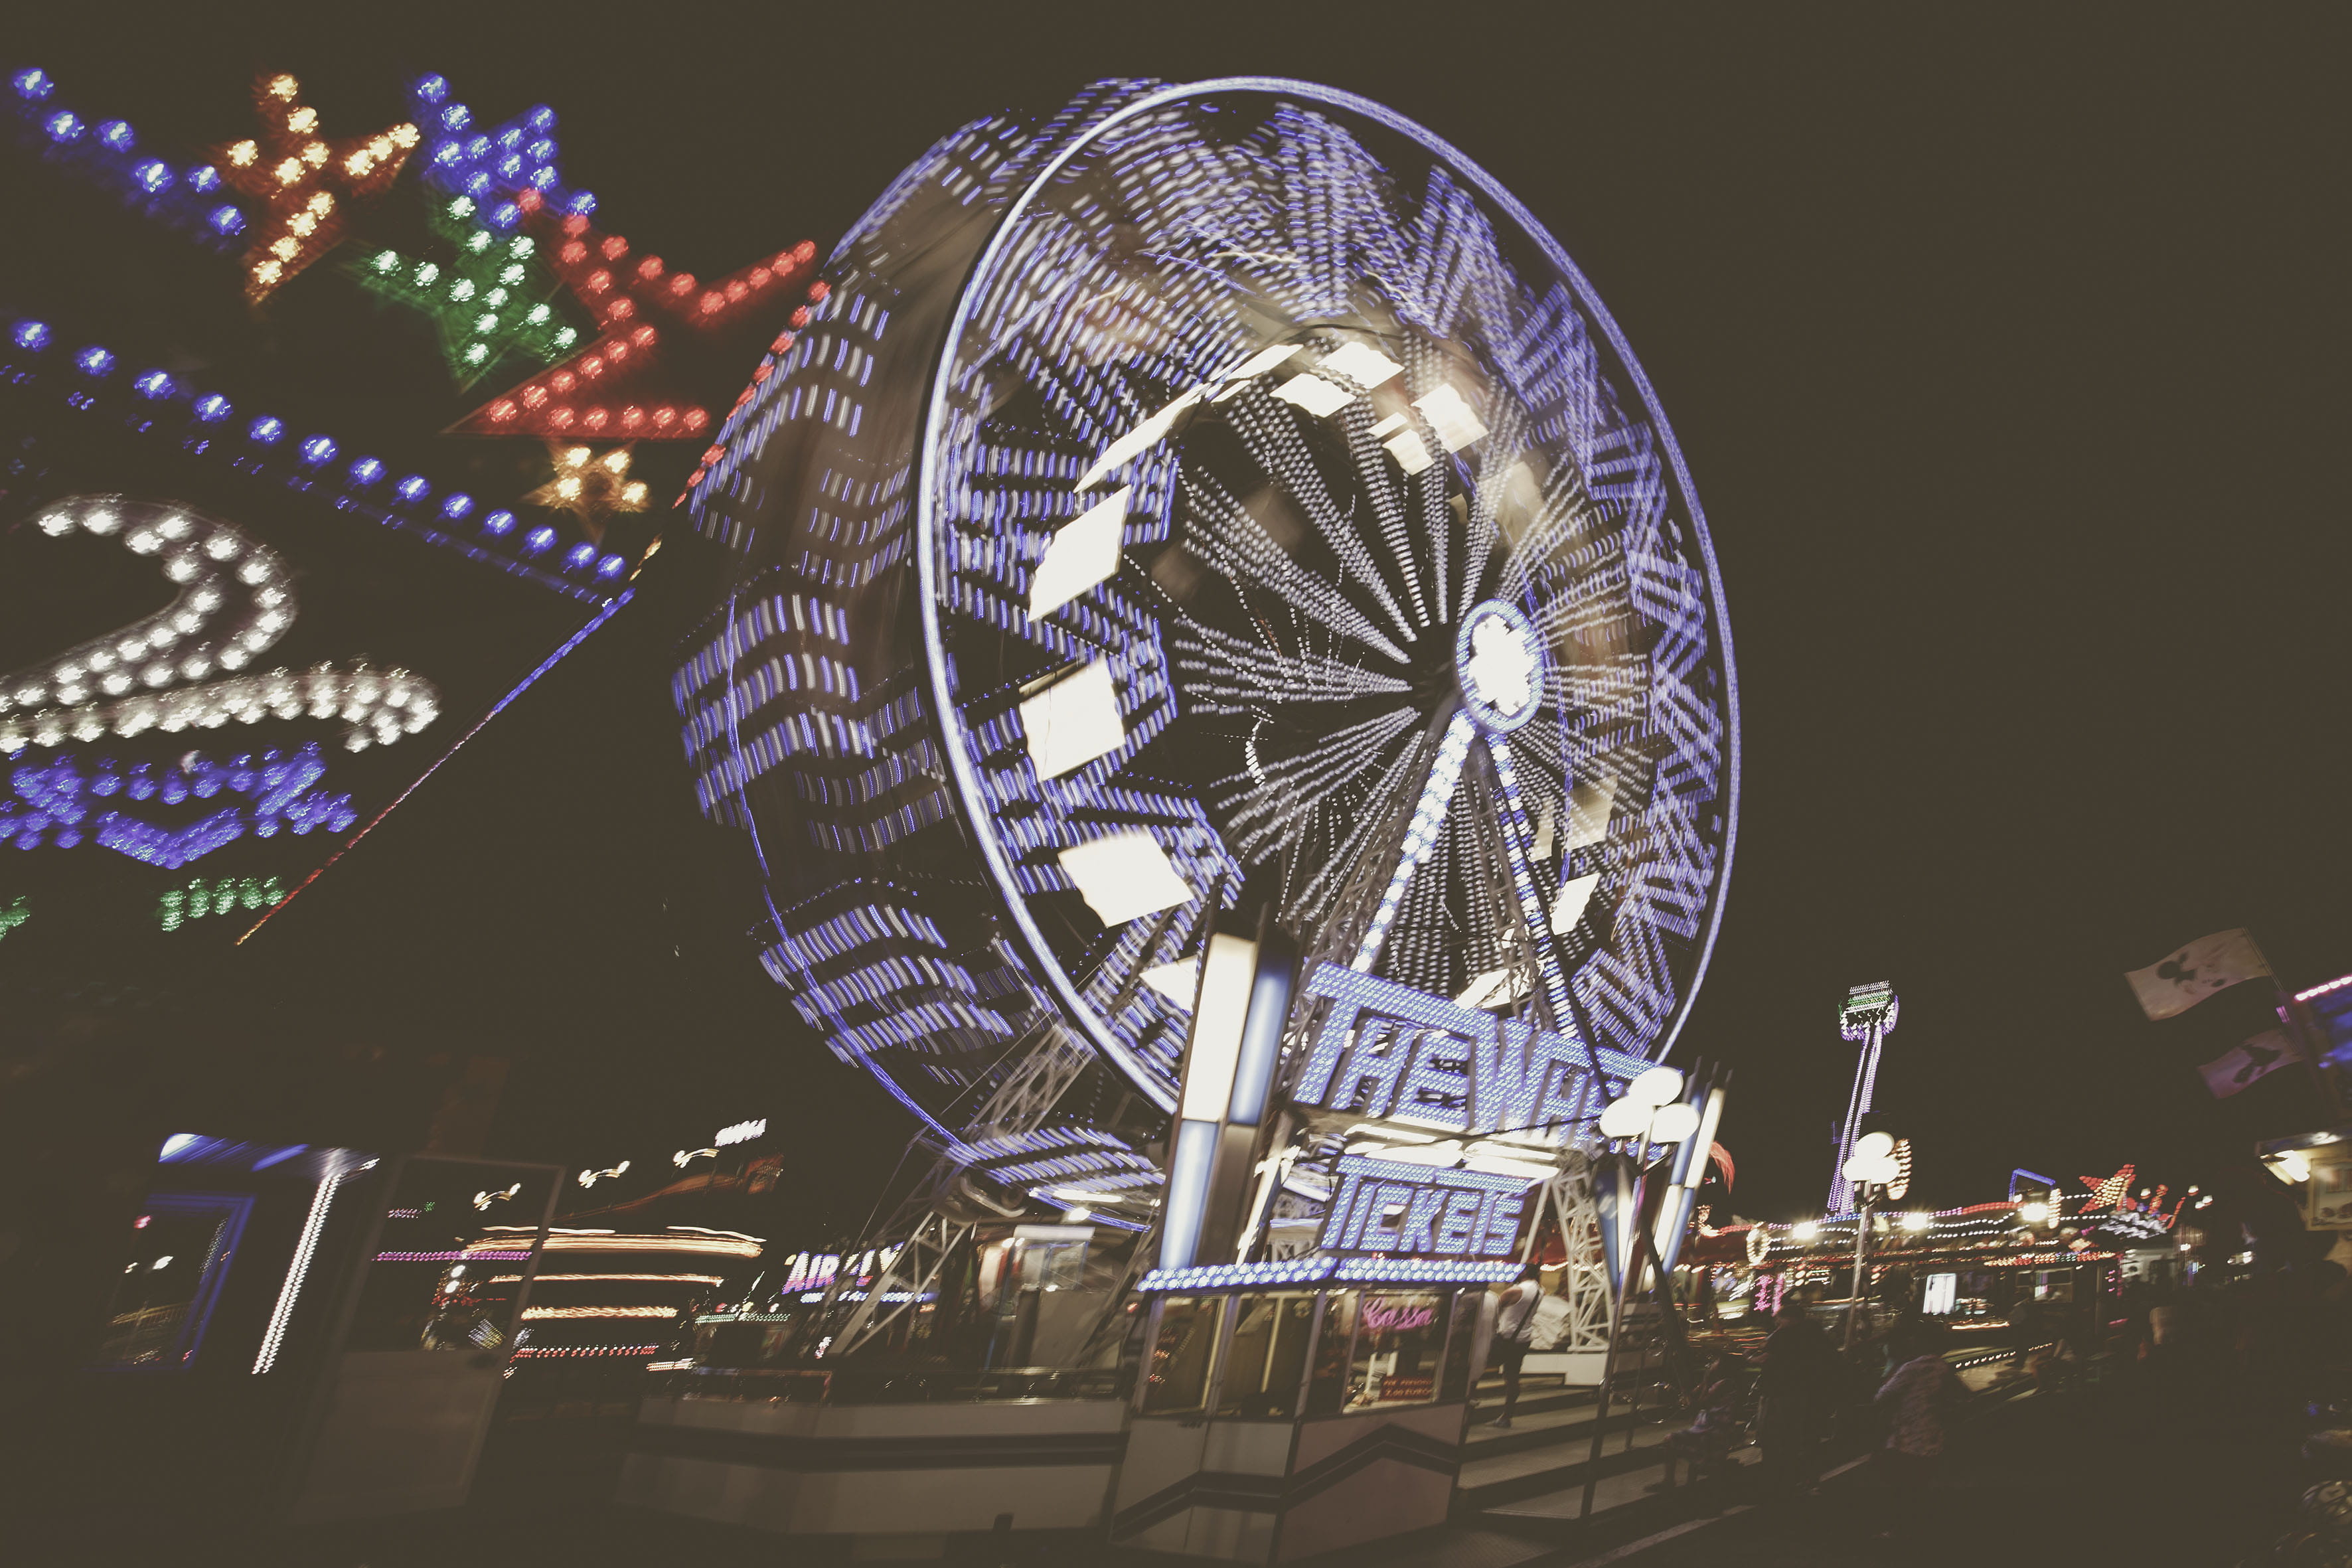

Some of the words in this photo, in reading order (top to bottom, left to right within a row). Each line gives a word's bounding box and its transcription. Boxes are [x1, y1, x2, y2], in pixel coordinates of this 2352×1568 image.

[1293, 961, 1487, 1130] THE
[1320, 1154, 1530, 1256] TICKETS
[1363, 1295, 1435, 1330] Cassa
